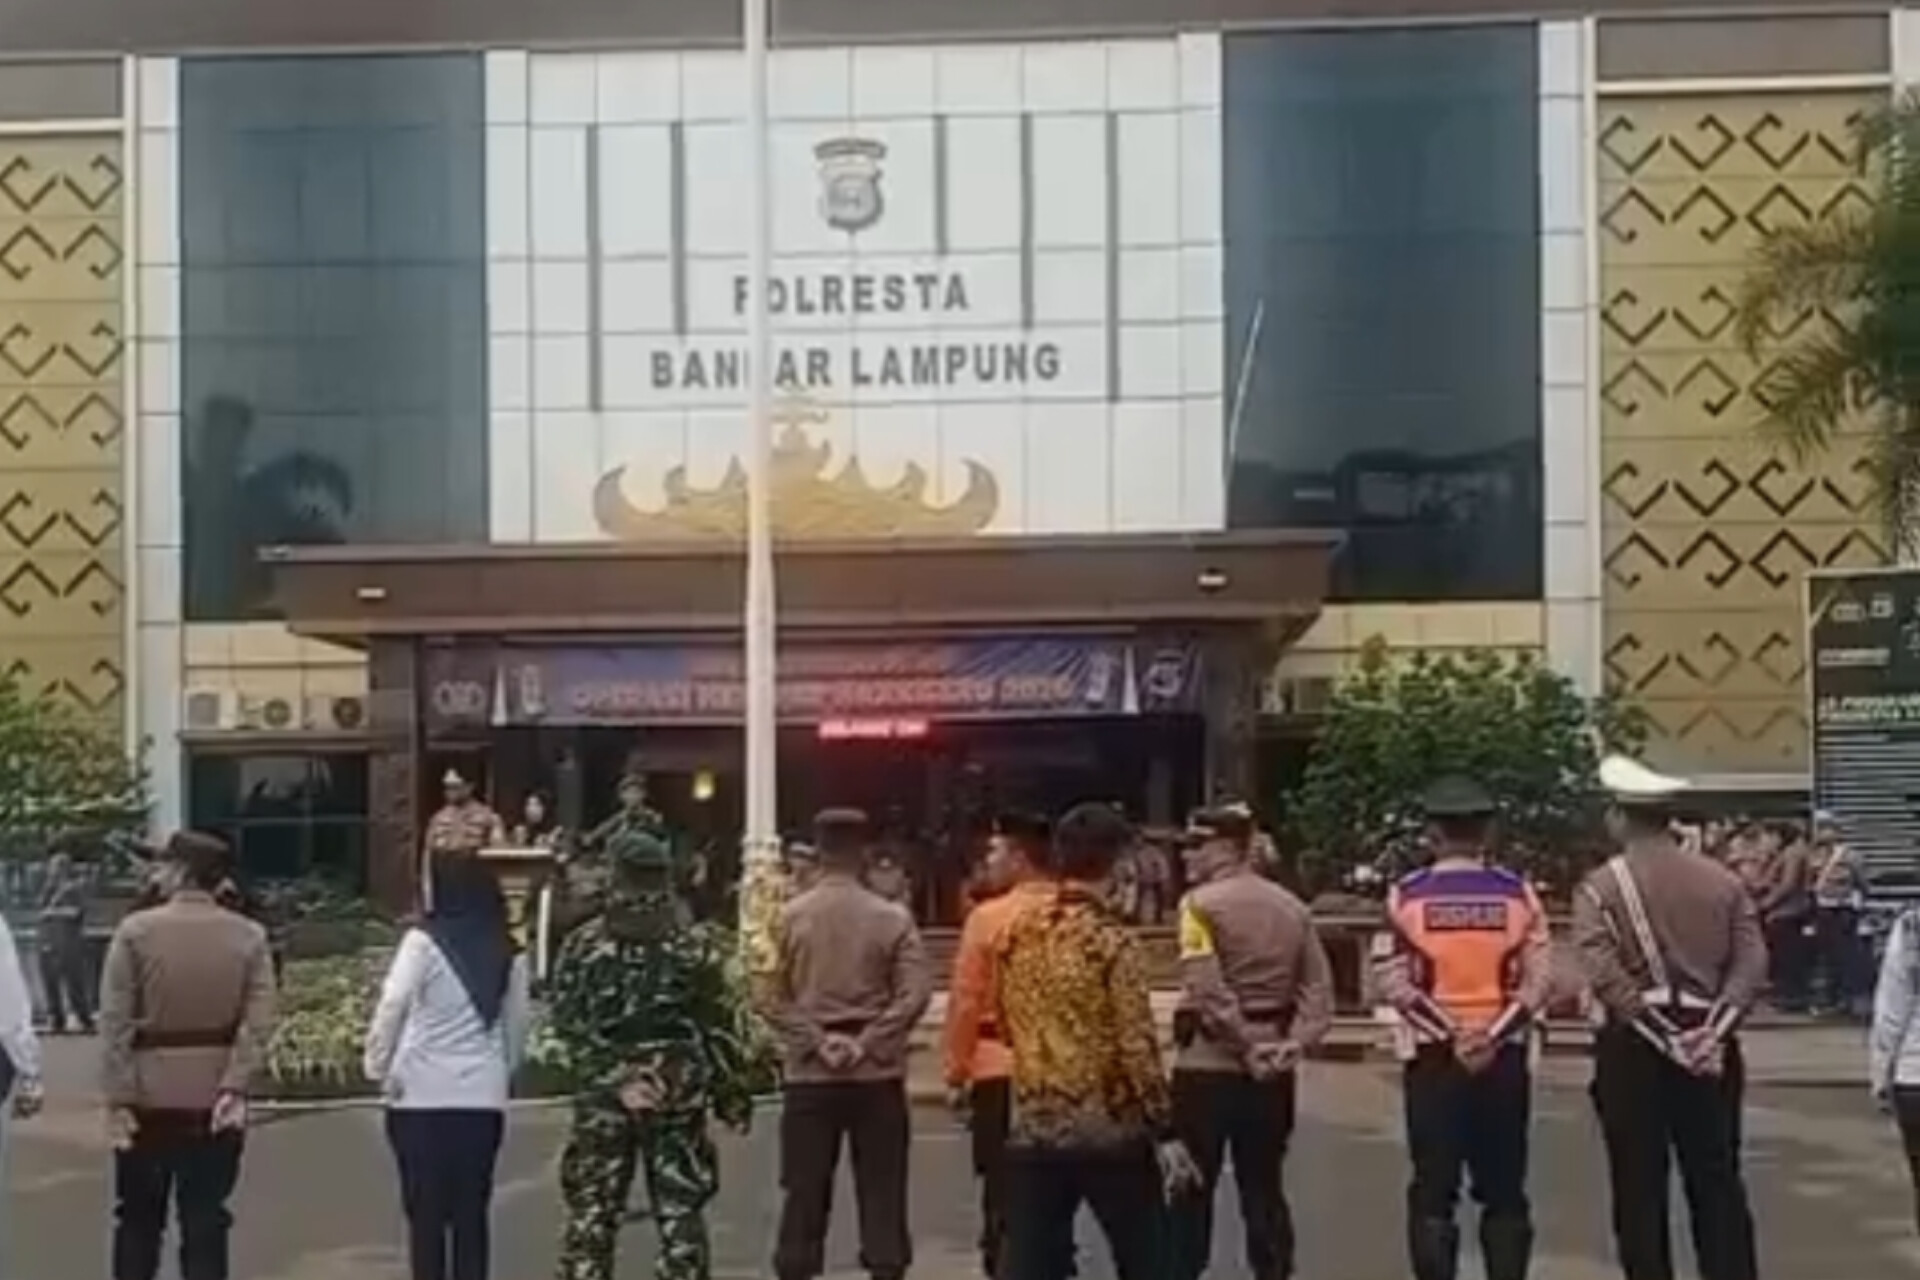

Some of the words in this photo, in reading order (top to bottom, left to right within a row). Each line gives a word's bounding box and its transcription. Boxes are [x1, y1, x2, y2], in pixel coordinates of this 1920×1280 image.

[734, 273, 970, 315] POLRESTA
[650, 348, 833, 389] BANAR
[850, 343, 1062, 387] LAMPUNG
